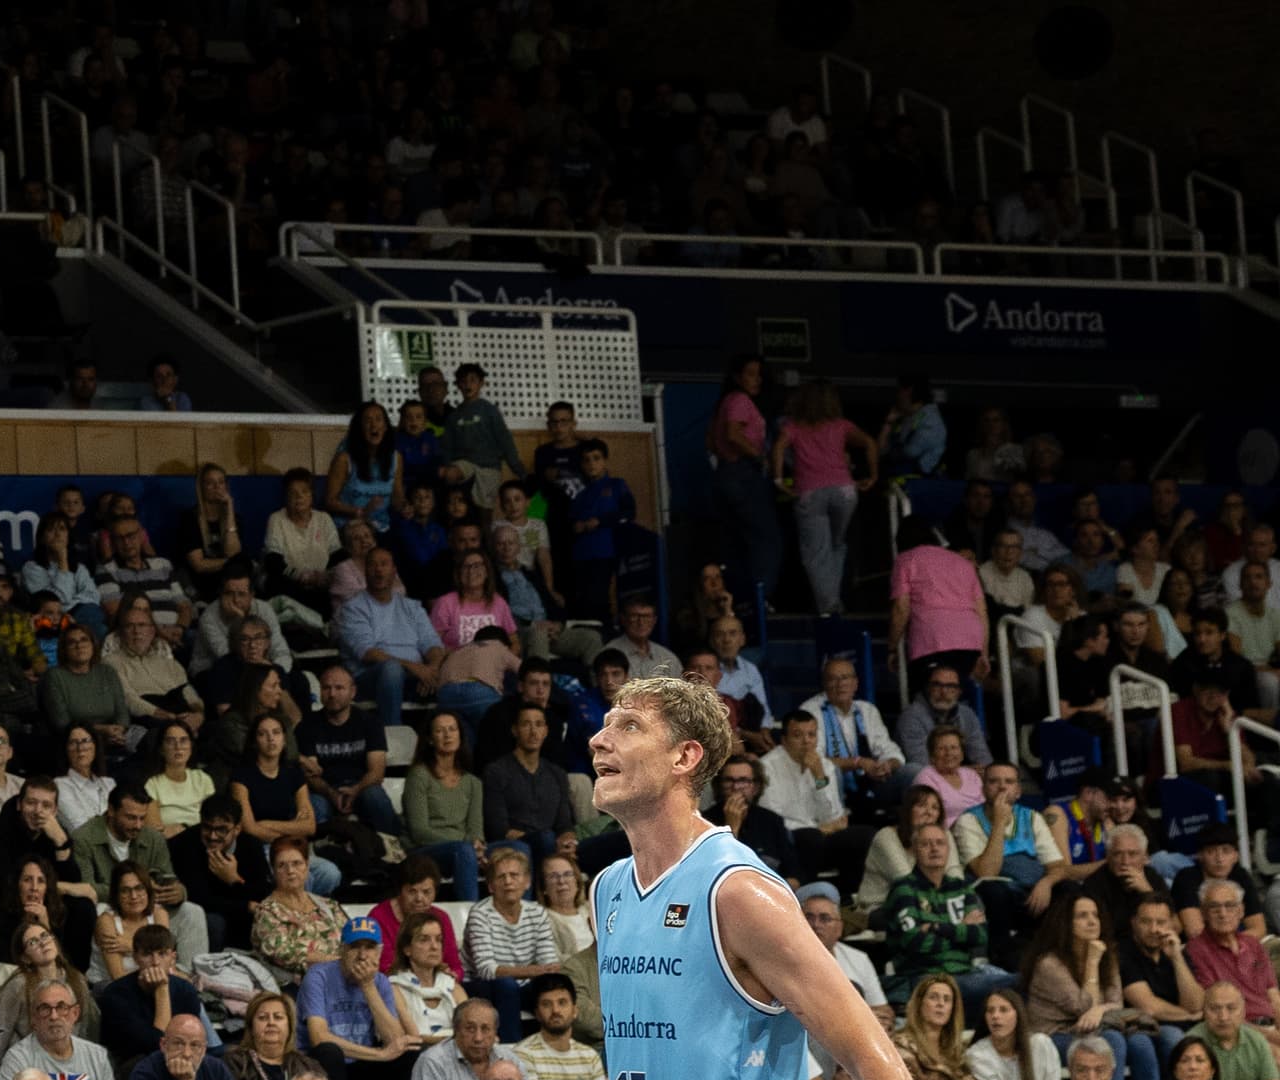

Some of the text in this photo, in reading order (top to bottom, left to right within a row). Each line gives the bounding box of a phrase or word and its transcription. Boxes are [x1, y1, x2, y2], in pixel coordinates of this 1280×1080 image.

[983, 298, 1105, 333] Andorra
[607, 955, 683, 977] MORABANC
[608, 1013, 678, 1041] Andorra
